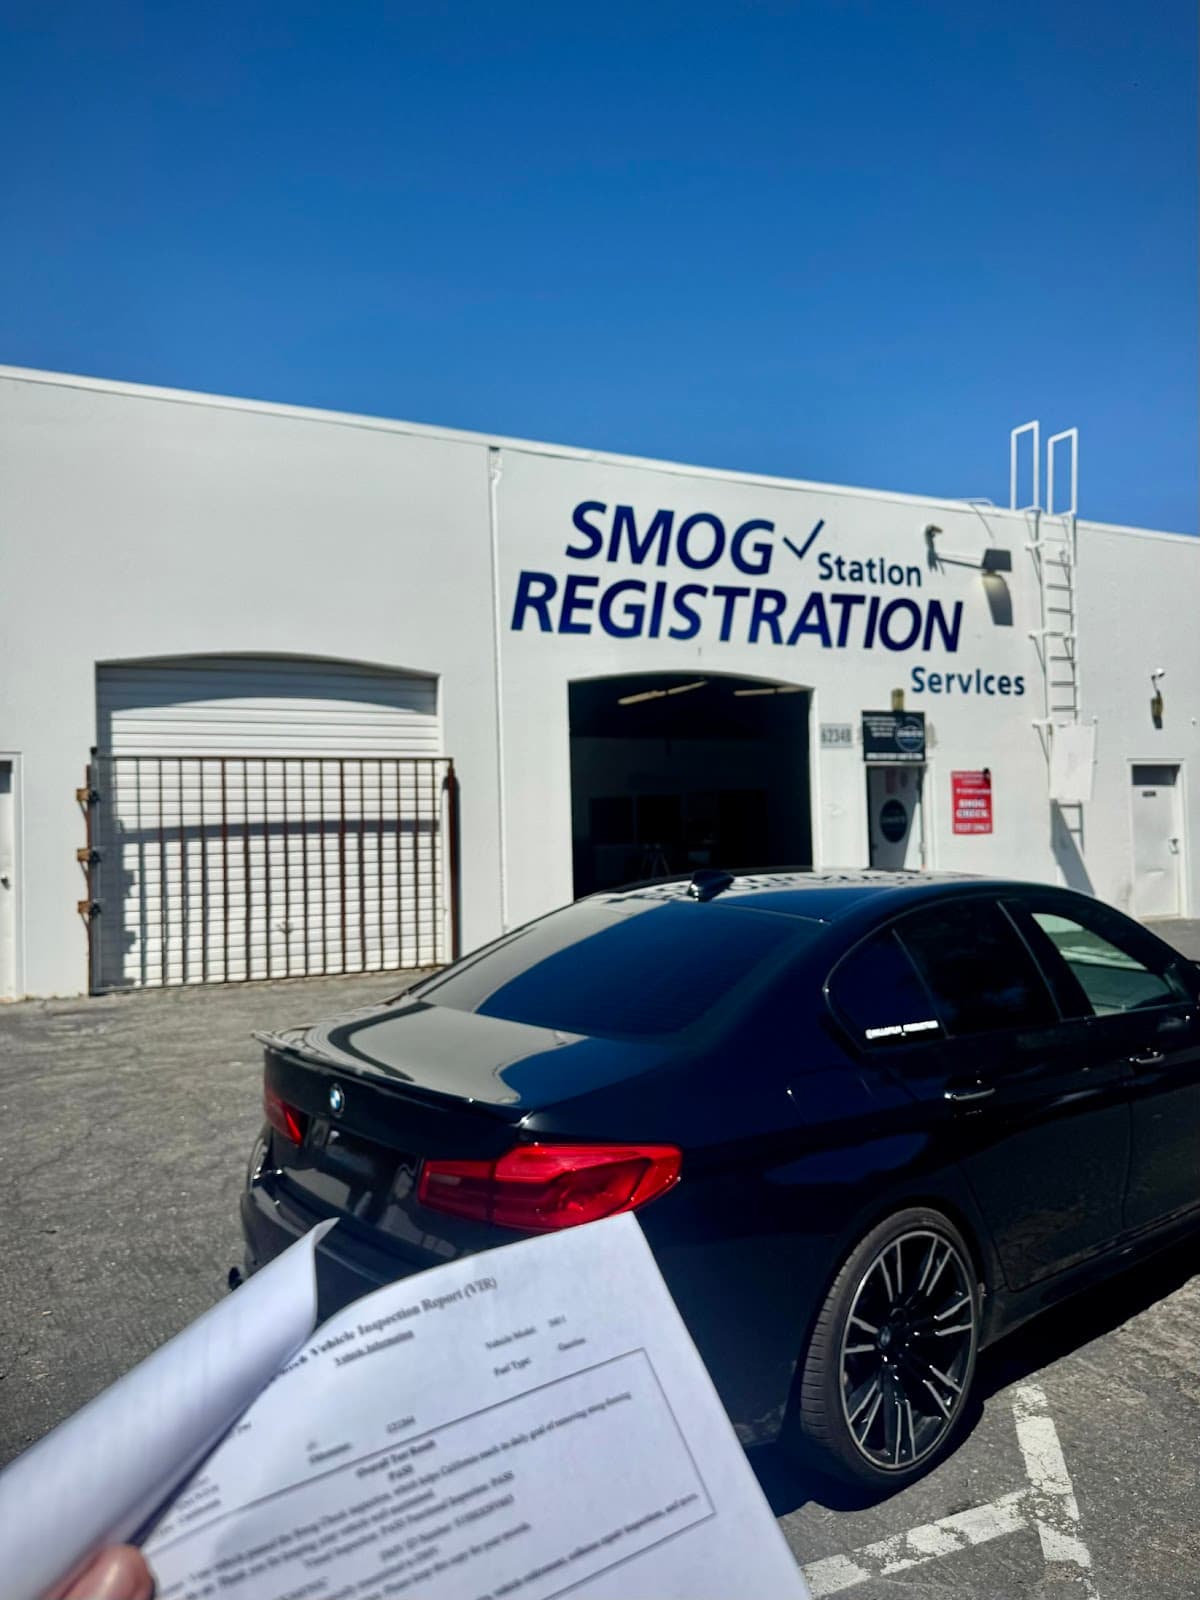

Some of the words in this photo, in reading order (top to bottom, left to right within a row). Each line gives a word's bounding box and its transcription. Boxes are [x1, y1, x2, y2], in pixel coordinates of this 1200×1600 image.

[565, 500, 775, 575] SMOG
[817, 552, 922, 587] Station
[510, 570, 964, 653] REGISTRATION
[911, 667, 1025, 696] Services
[357, 1305, 421, 1336] Inspection
[421, 1291, 463, 1313] Report
